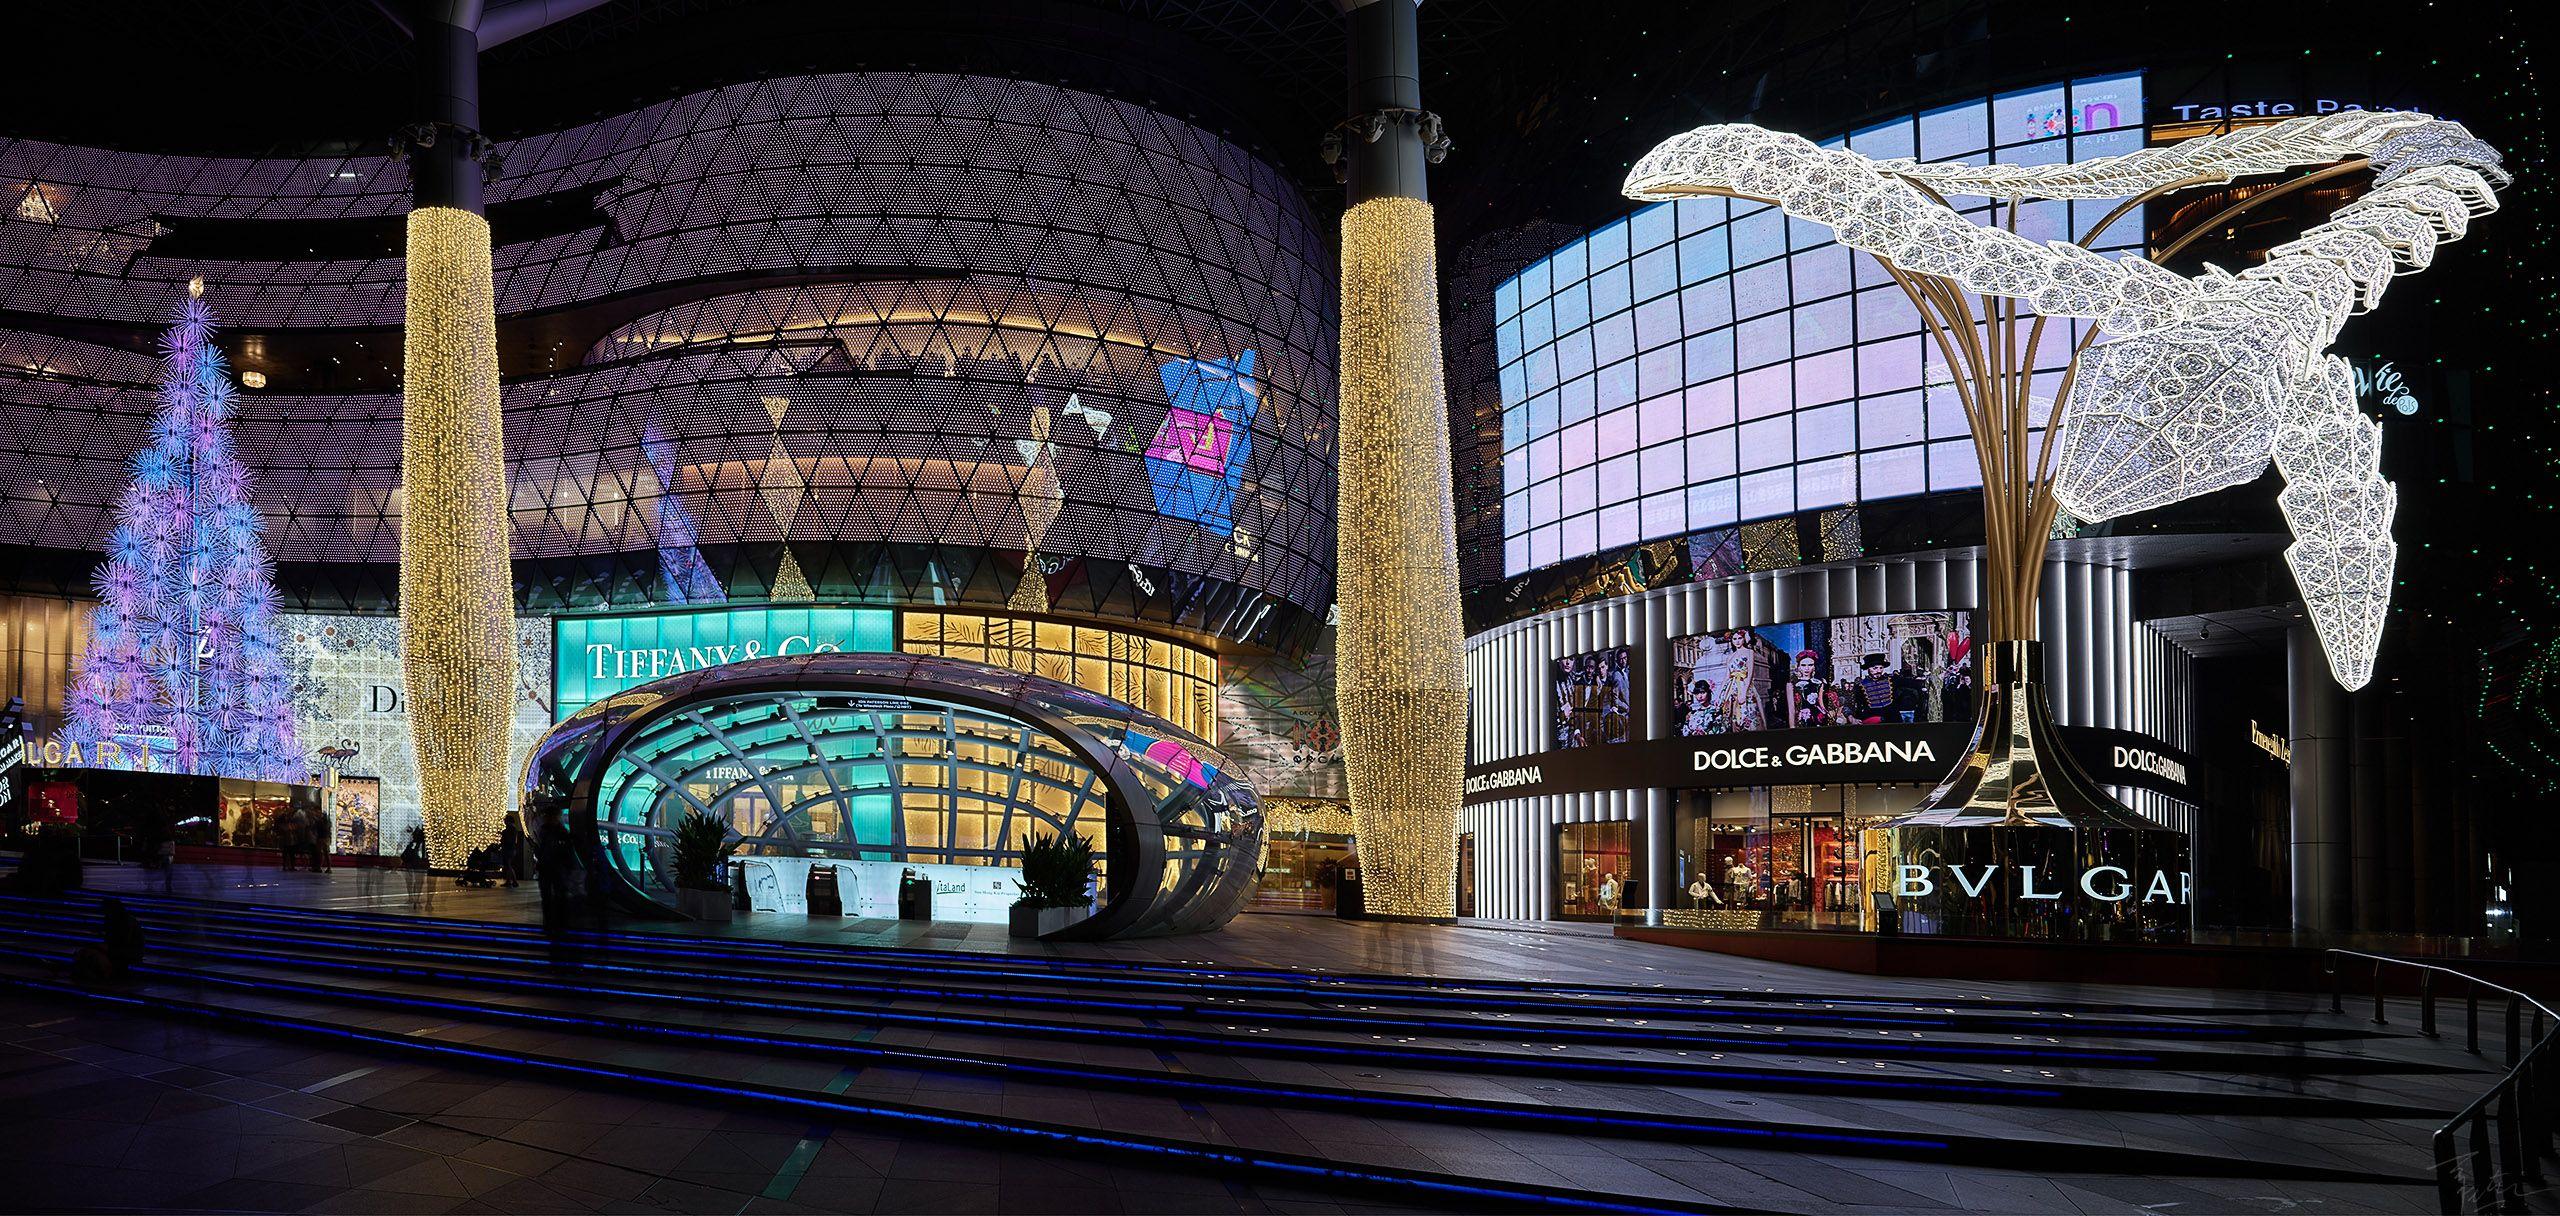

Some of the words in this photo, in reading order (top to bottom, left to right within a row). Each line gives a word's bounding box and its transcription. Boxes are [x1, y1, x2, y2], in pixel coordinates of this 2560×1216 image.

[2172, 100, 2295, 121] Taste
[742, 639, 771, 659] &
[1694, 747, 1769, 771] DOLCE
[1771, 756, 1783, 768] &
[1785, 740, 1936, 766] GABBANA
[2114, 745, 2156, 774] DOLCE
[1465, 774, 1487, 795] DOLCE
[1489, 765, 1542, 789] GABBANA
[1898, 864, 2191, 905] BVLGAR
